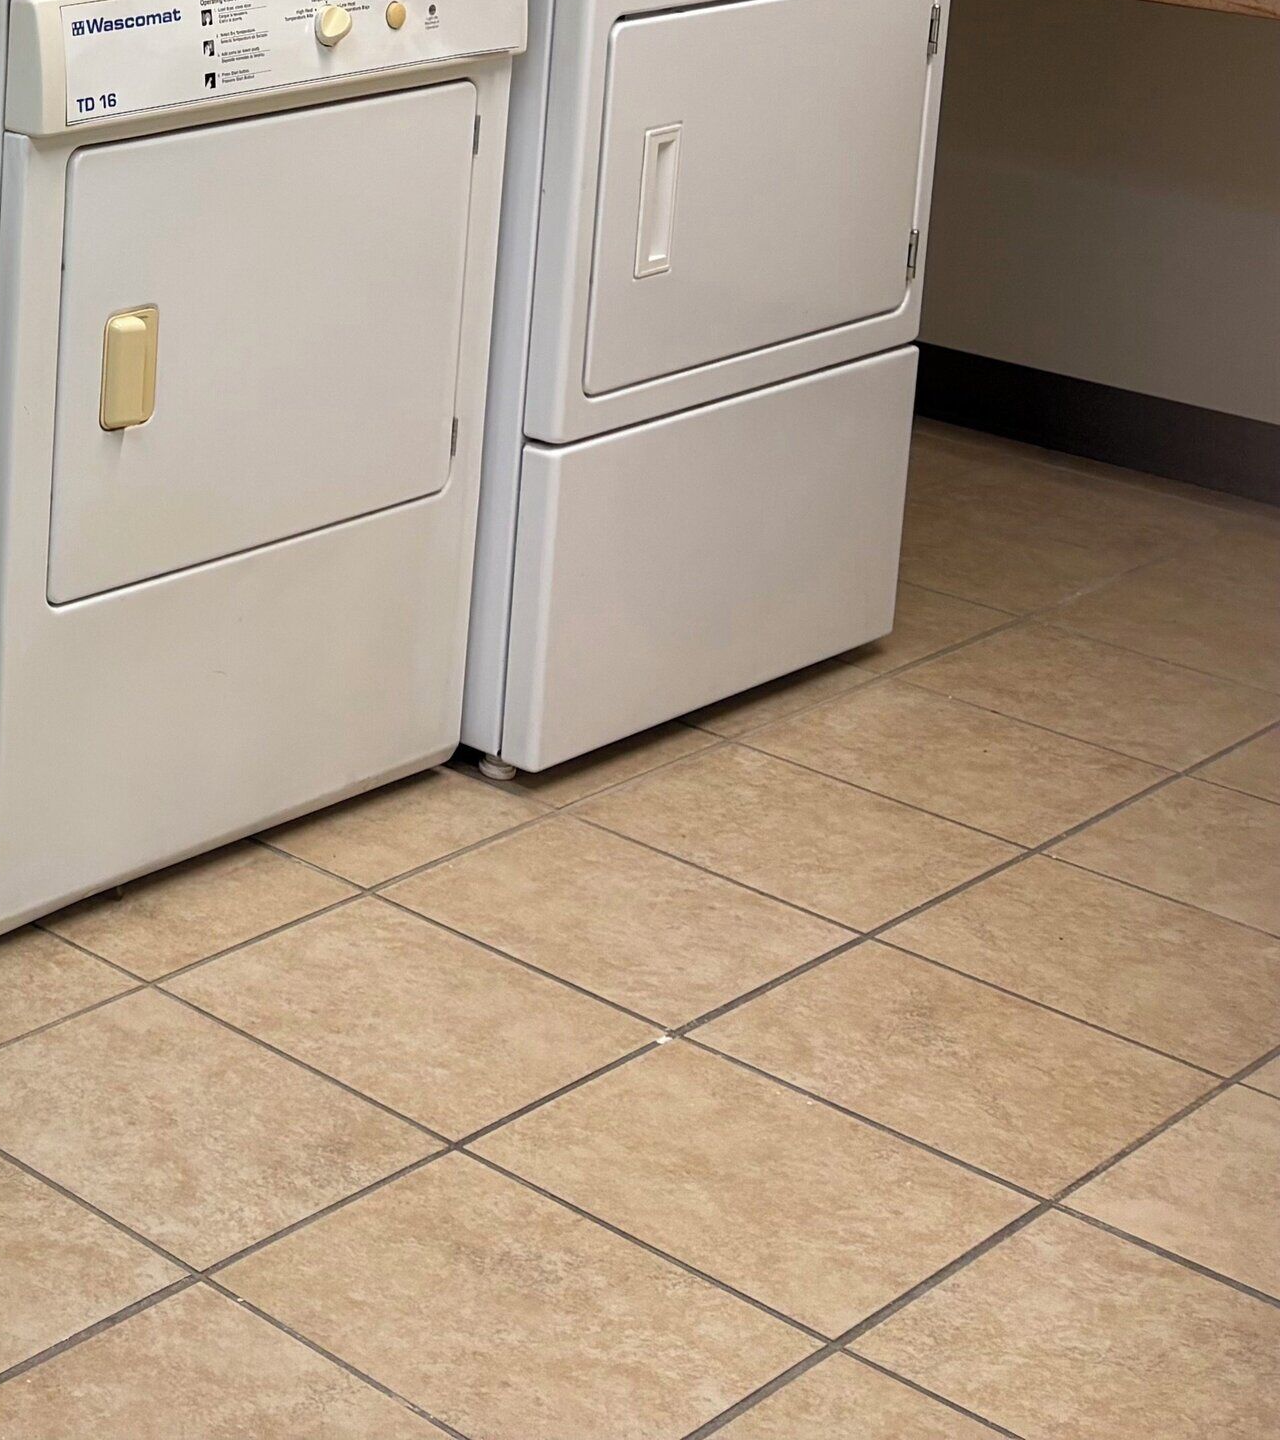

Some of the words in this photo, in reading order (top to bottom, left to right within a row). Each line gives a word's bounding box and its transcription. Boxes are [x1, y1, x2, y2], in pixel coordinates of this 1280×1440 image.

[86, 8, 182, 34] Wascomat
[76, 97, 95, 113] TD
[99, 93, 117, 109] 16
